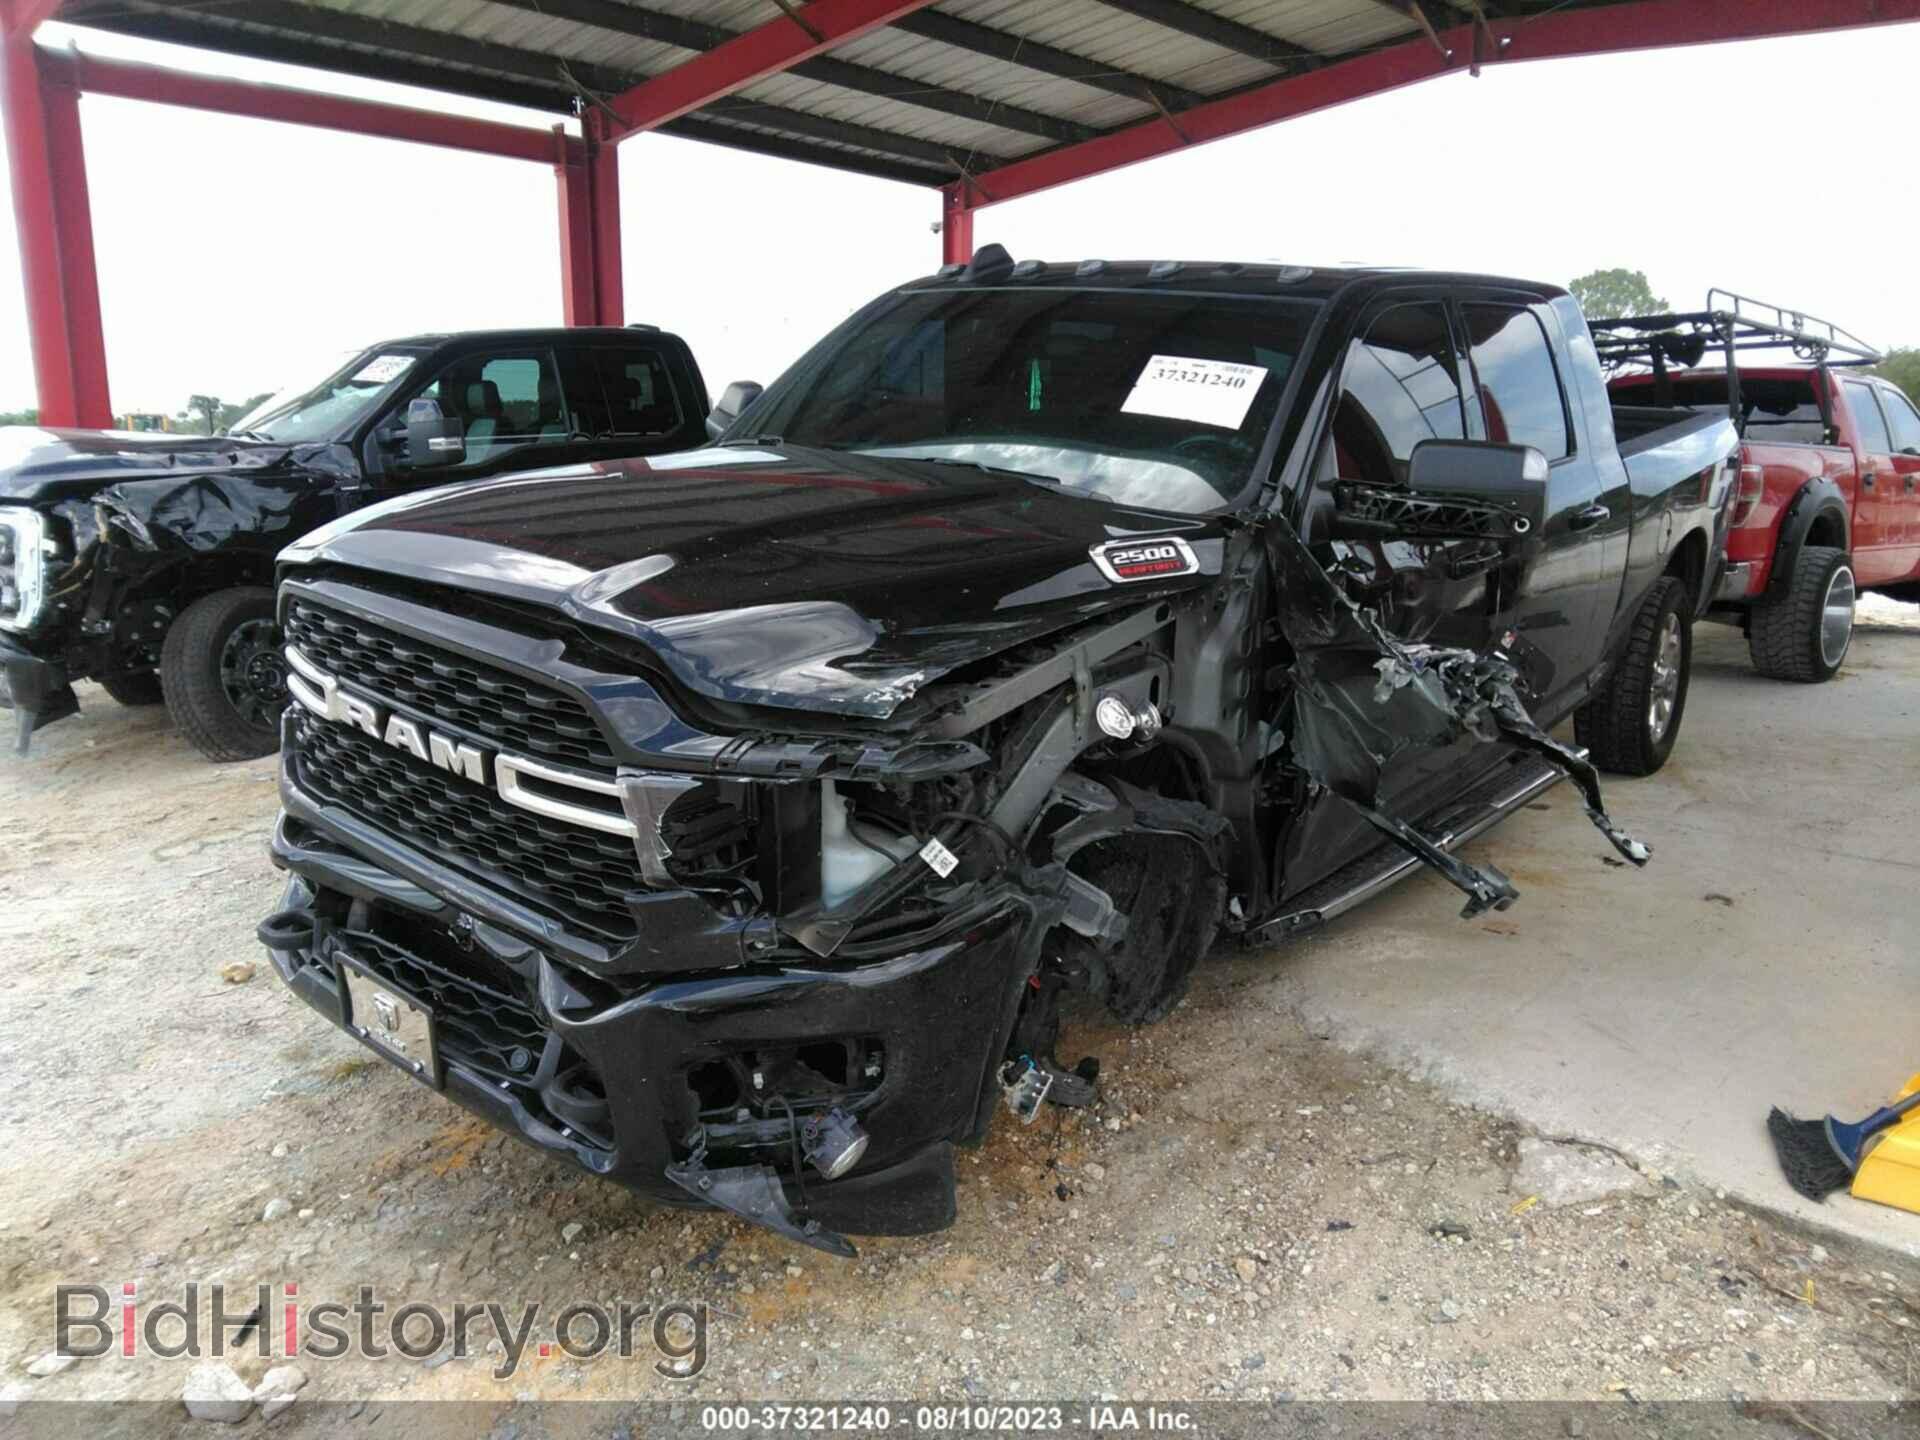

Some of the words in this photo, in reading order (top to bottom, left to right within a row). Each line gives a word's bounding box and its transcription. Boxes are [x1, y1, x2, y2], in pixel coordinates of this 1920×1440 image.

[1152, 368, 1247, 390] 37321240
[1111, 546, 1177, 564] 2500
[335, 690, 486, 785] RAM
